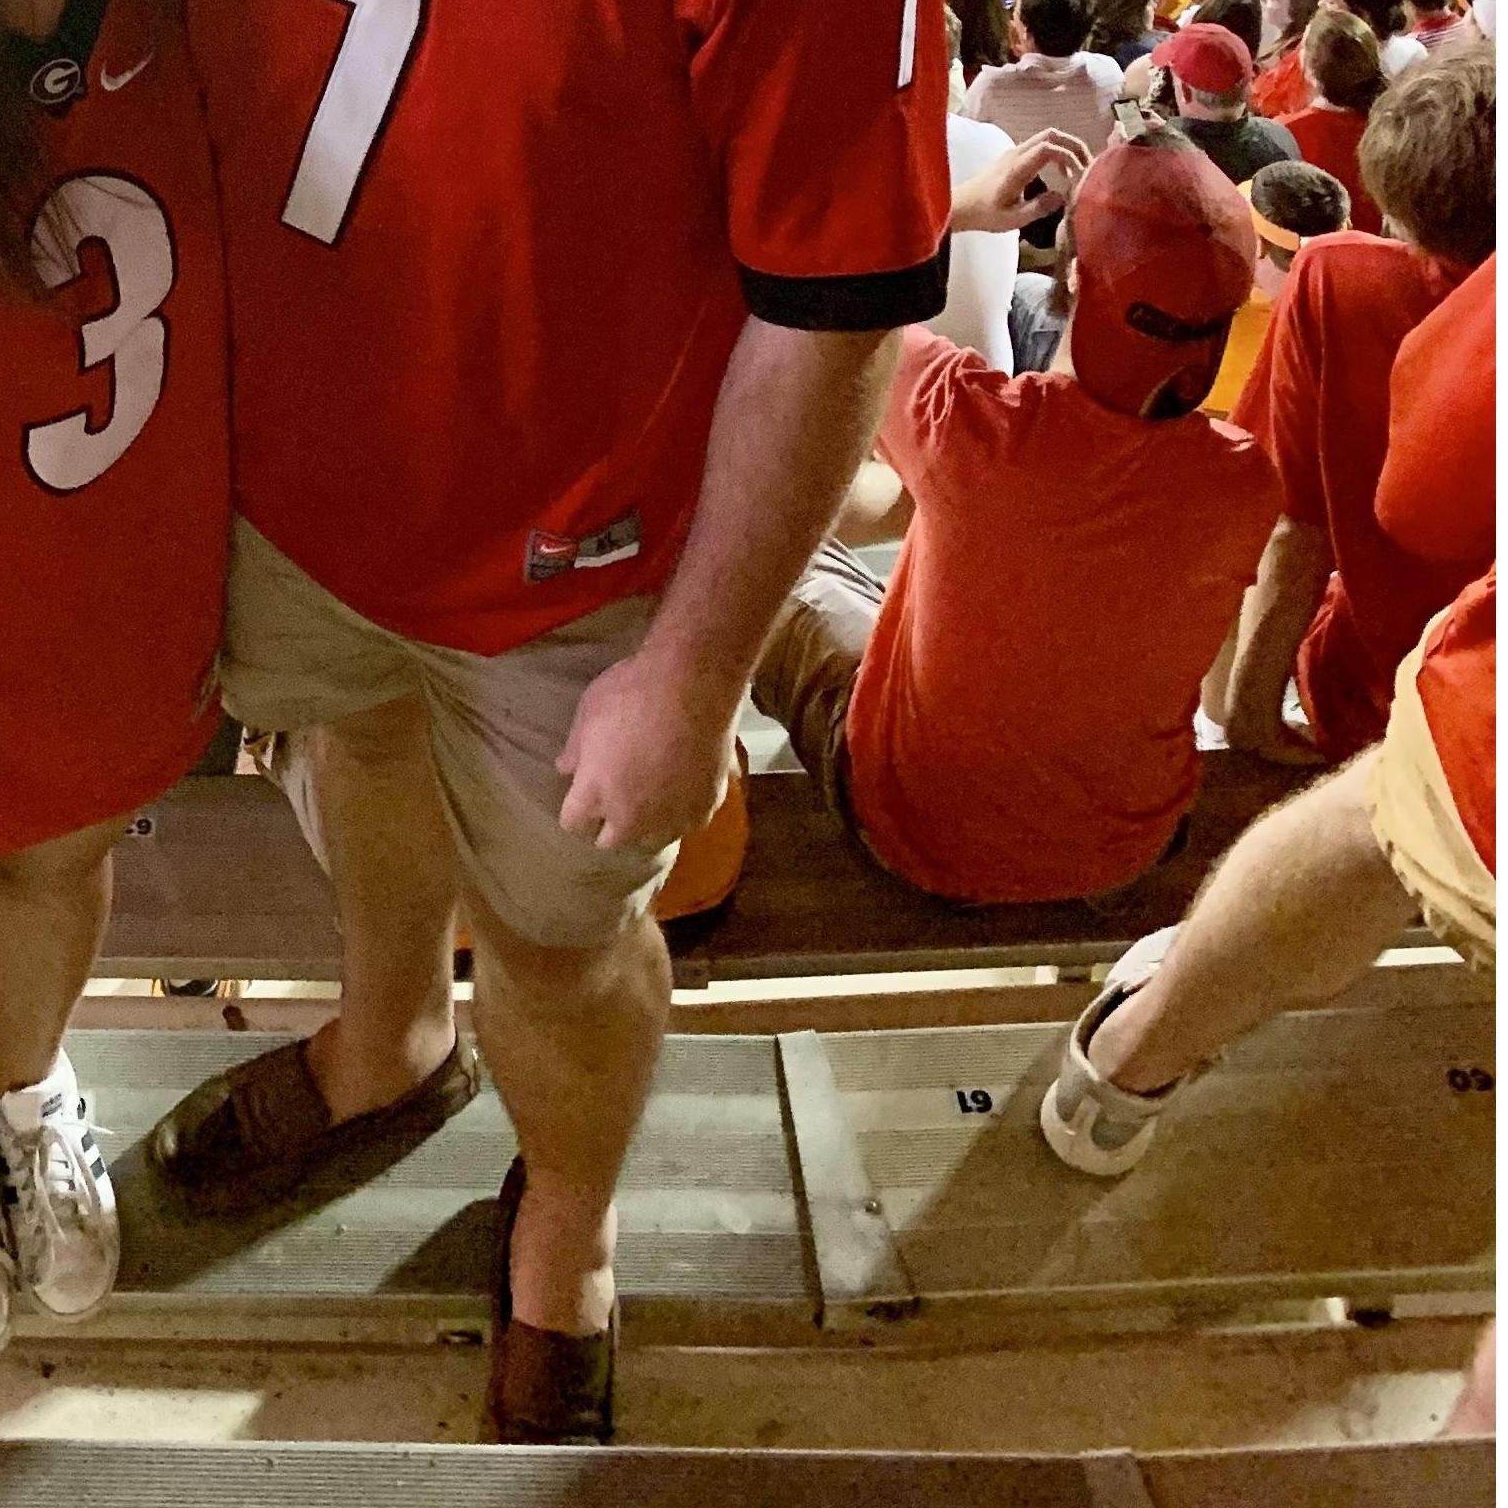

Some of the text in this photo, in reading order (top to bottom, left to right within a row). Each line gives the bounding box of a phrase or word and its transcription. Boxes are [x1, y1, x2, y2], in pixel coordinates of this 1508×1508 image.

[27, 175, 174, 490] 3
[124, 818, 152, 835] 6
[955, 1089, 993, 1114] 61
